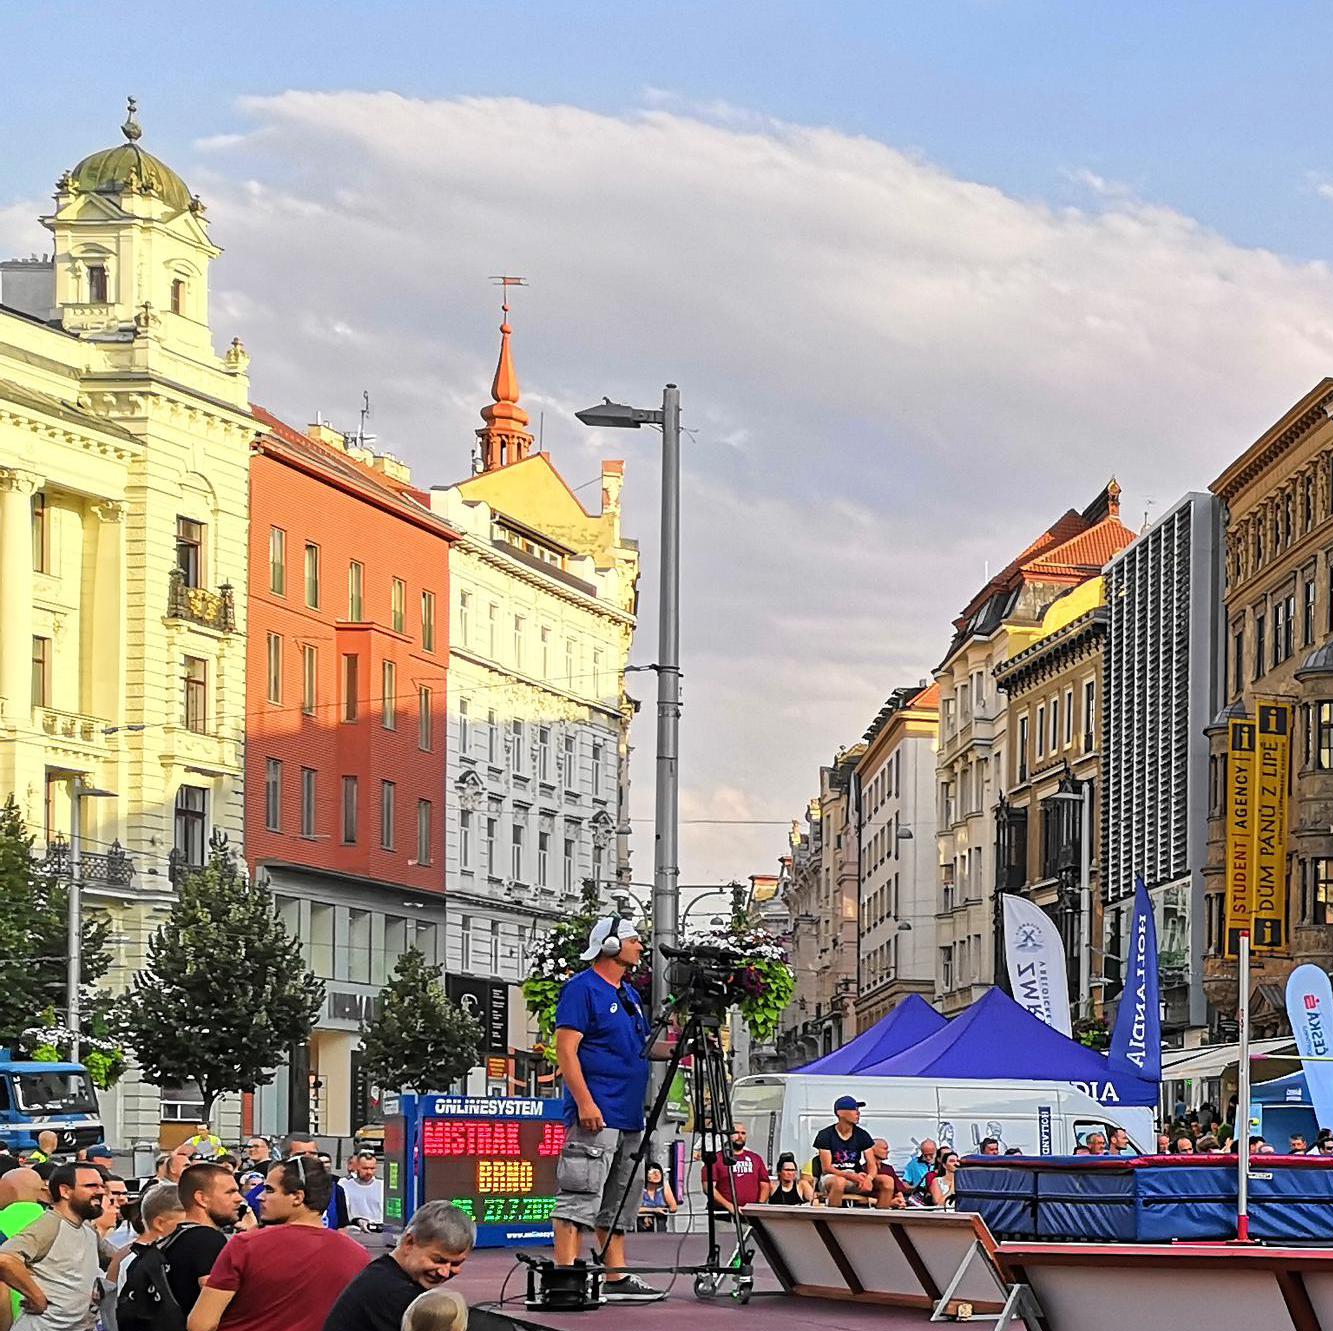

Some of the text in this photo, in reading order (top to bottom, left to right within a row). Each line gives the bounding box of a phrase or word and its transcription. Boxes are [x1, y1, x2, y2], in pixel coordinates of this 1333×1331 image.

[1268, 786, 1277, 797] Z
[1232, 765, 1249, 914] STUDENT AGENCY
[1260, 805, 1277, 856] PÁNŮ
[1258, 865, 1275, 912] DŮM
[435, 1098, 543, 1116] ONLINESYSTEM
[478, 1160, 533, 1193] BRNO
